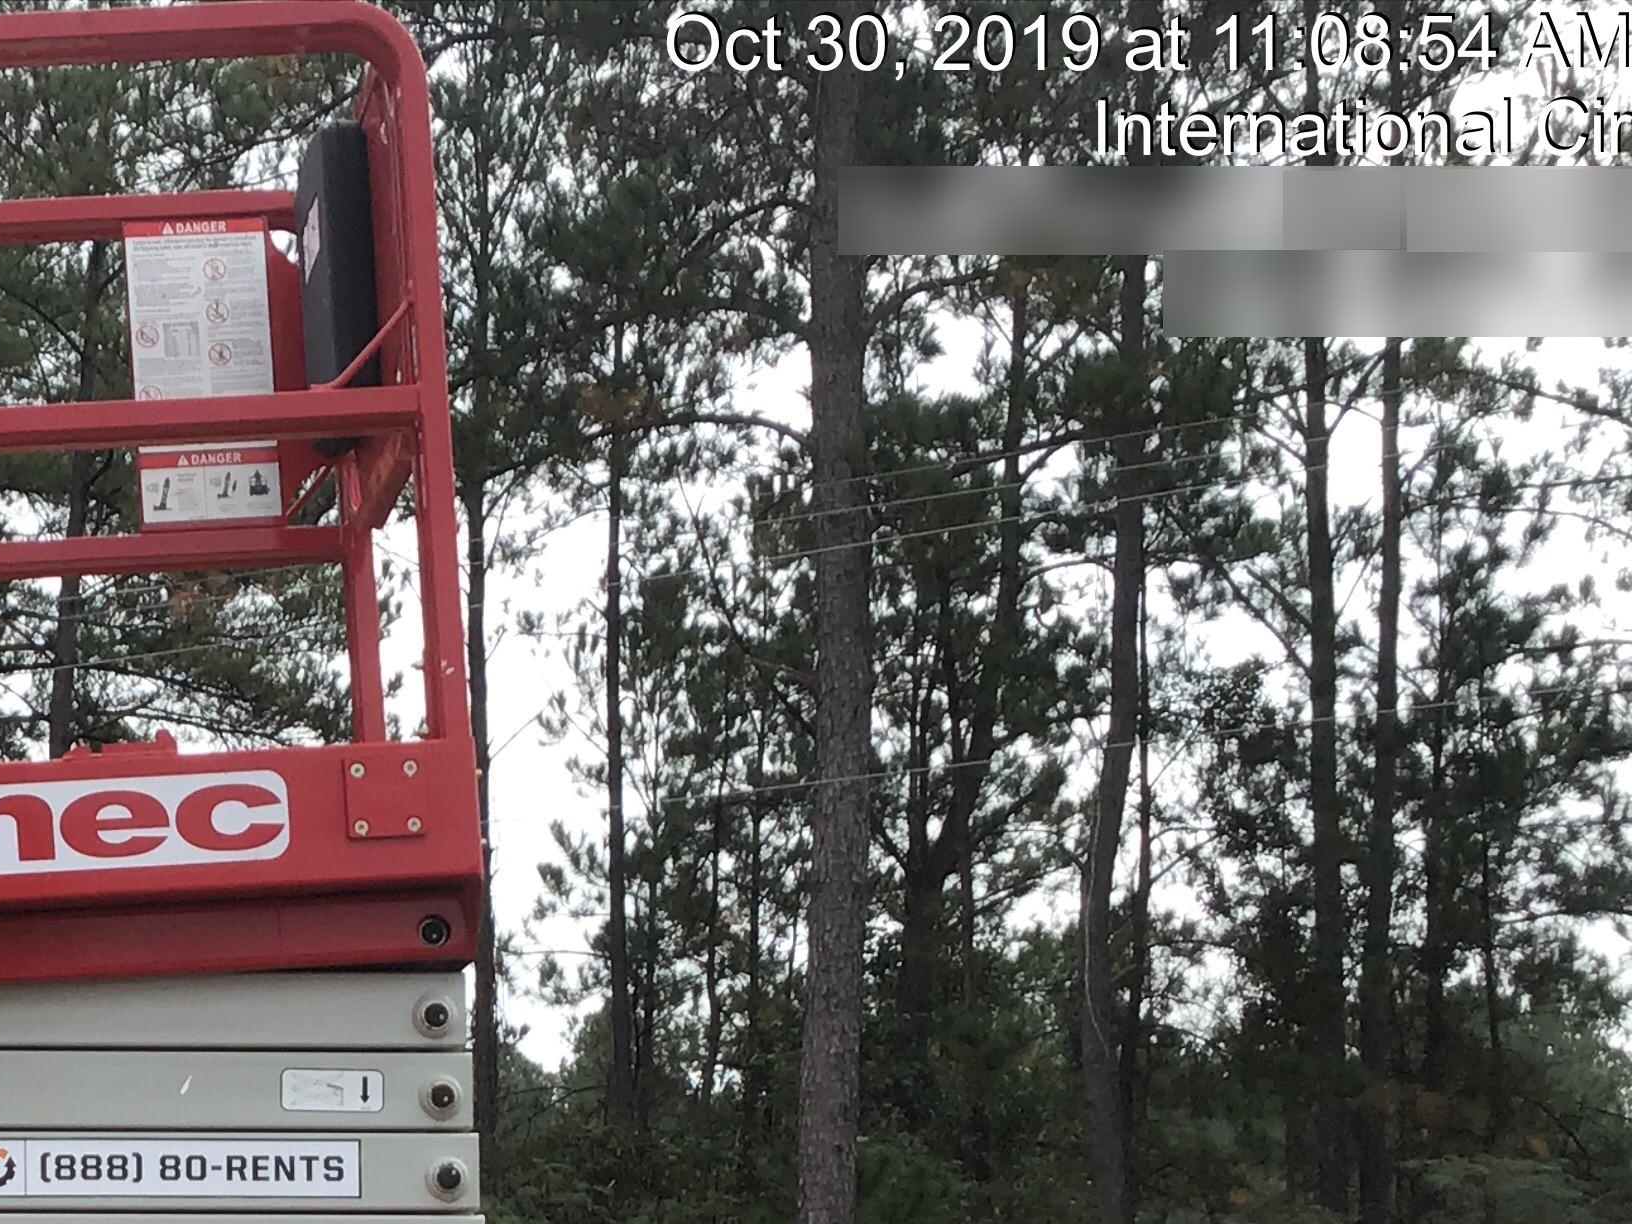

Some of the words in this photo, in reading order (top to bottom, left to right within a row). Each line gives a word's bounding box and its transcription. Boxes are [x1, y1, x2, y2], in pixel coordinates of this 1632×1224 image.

[175, 220, 227, 235] DANGER
[190, 452, 242, 466] DANGER
[39, 1151, 144, 1184] (888)
[159, 1153, 345, 1183] 80-RENTS
